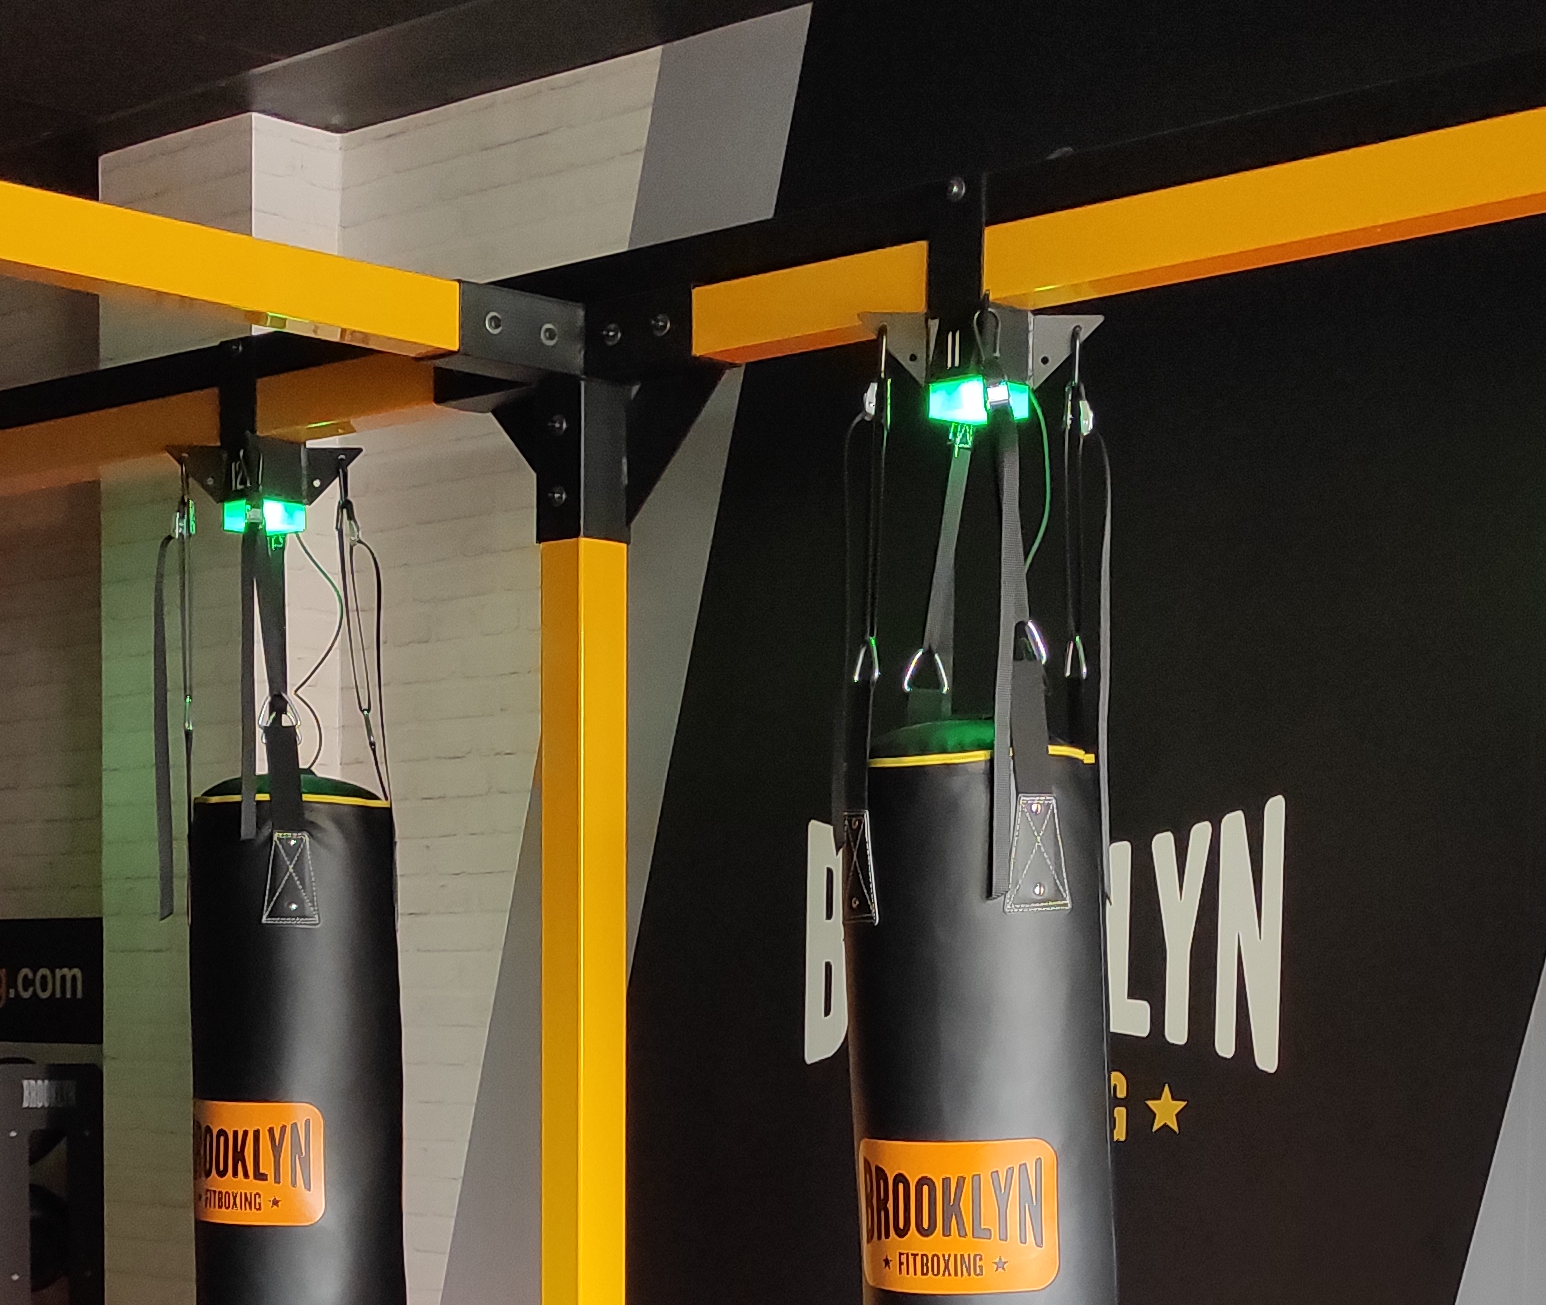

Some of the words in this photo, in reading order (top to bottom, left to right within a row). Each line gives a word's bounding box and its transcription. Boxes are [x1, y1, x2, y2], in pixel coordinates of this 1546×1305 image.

[804, 794, 1285, 1073] BLYN
[864, 1156, 1044, 1249] BROOKLYN
[898, 1251, 984, 1278] FITBOXING
